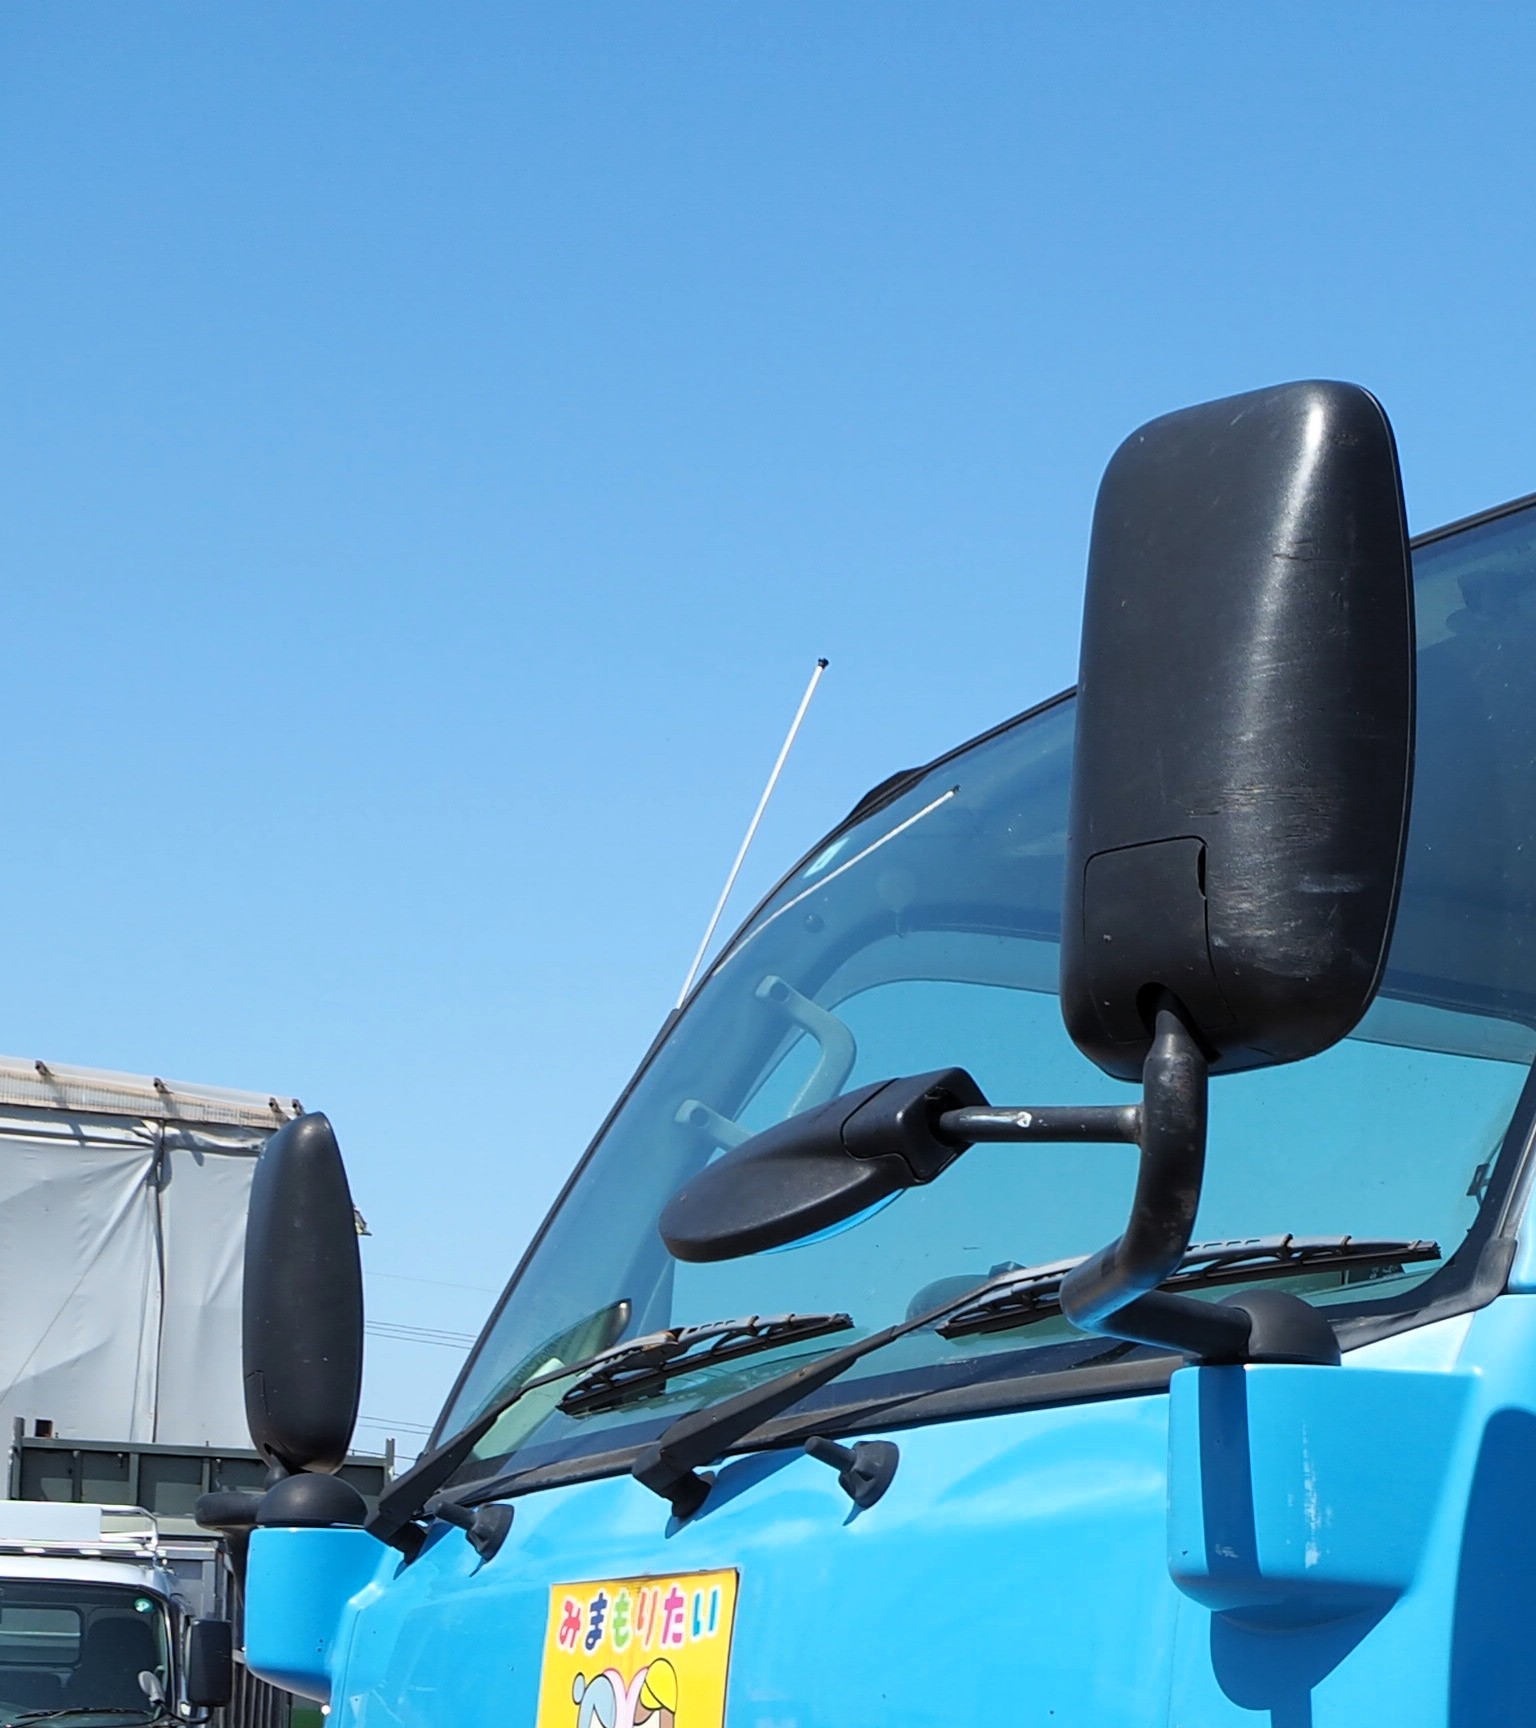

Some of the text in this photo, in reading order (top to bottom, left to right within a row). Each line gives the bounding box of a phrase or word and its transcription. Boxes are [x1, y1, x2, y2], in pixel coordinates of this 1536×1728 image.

[558, 1587, 719, 1651] みまもりたい
